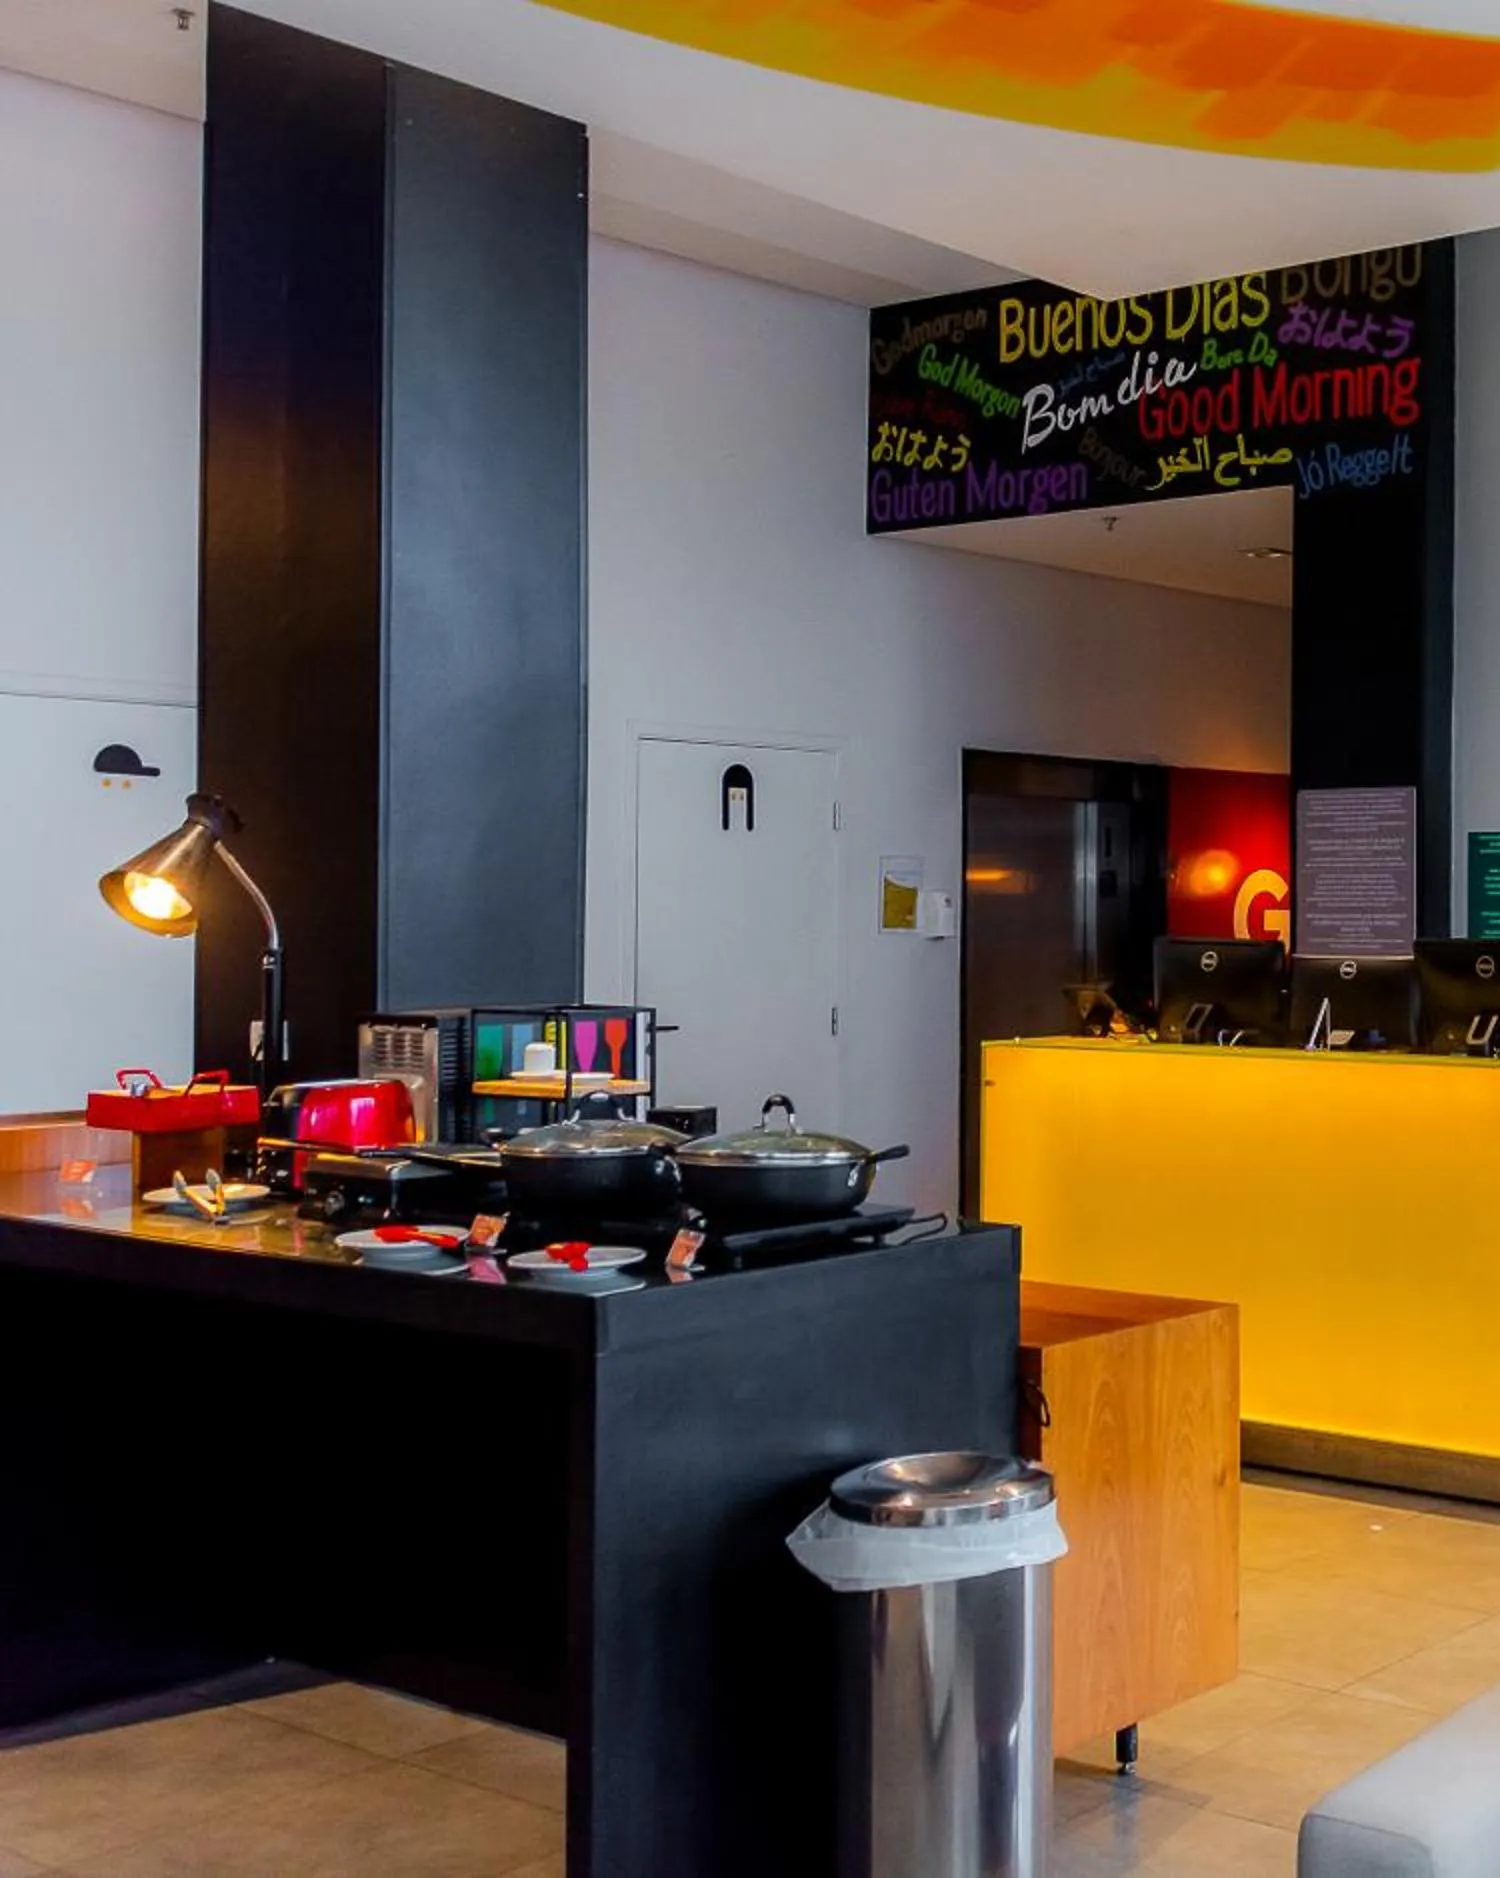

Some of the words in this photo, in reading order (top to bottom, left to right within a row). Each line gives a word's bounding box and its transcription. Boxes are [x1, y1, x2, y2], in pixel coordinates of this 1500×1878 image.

[998, 294, 1155, 364] Buenos
[1247, 331, 1279, 368] Da
[1276, 300, 1415, 358] おはよう
[917, 342, 961, 389] God
[1020, 383, 1114, 456] Bom
[1116, 349, 1198, 406] dia
[1137, 366, 1243, 441] Good
[1251, 356, 1422, 427] Morning
[871, 420, 972, 473] おはよう
[1144, 434, 1212, 491] الخير
[1213, 432, 1295, 487] صباح
[1325, 431, 1415, 489] Reggelt
[870, 466, 957, 525] Guten
[964, 456, 1089, 515] Morgen
